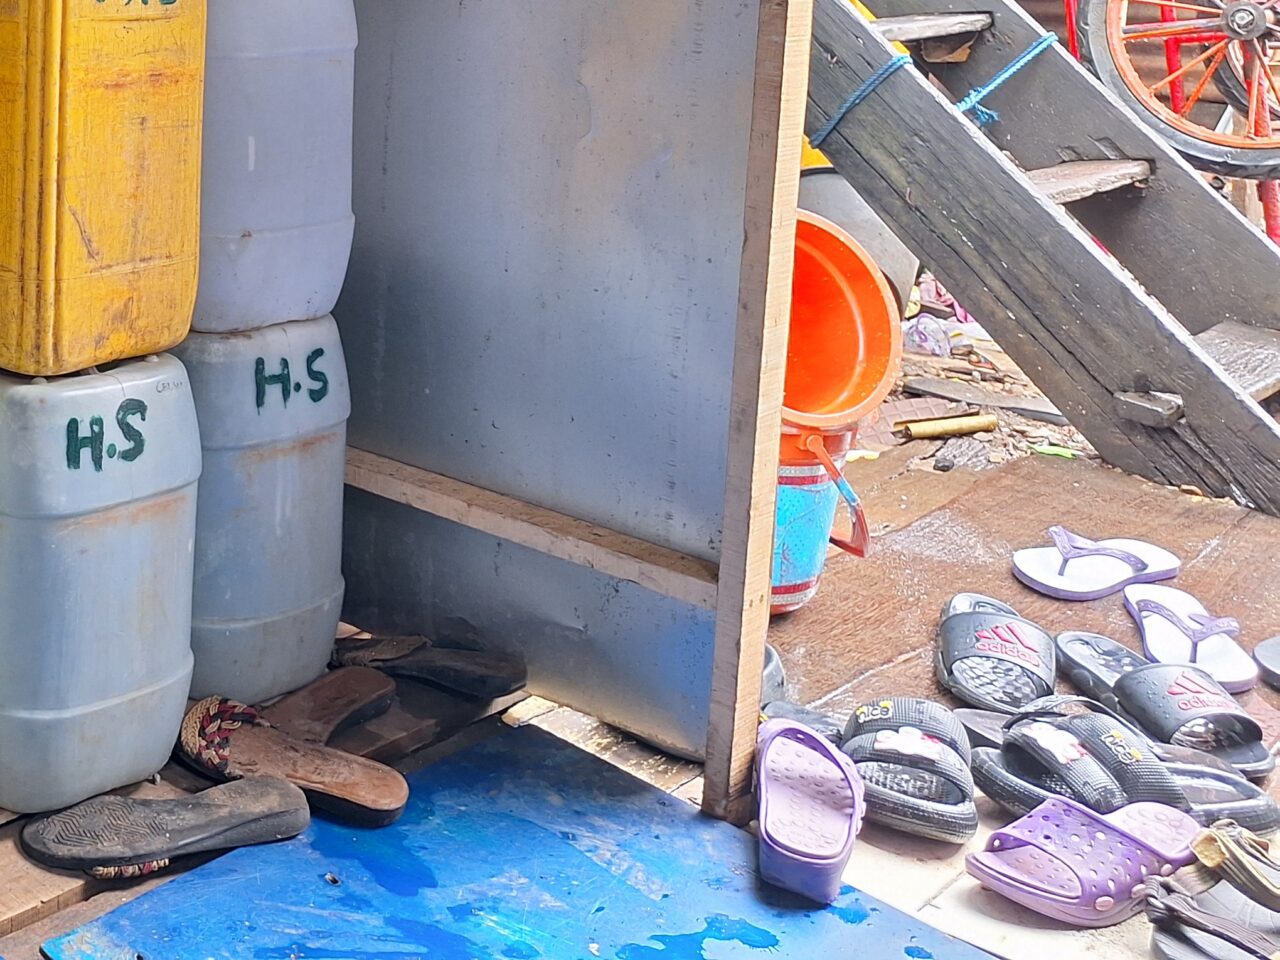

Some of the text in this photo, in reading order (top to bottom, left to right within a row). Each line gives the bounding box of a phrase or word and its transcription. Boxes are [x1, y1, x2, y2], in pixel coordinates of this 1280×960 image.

[255, 347, 329, 415] H.S
[66, 398, 148, 472] H.S
[1177, 695, 1235, 711] adi
[1100, 732, 1136, 764] nice
